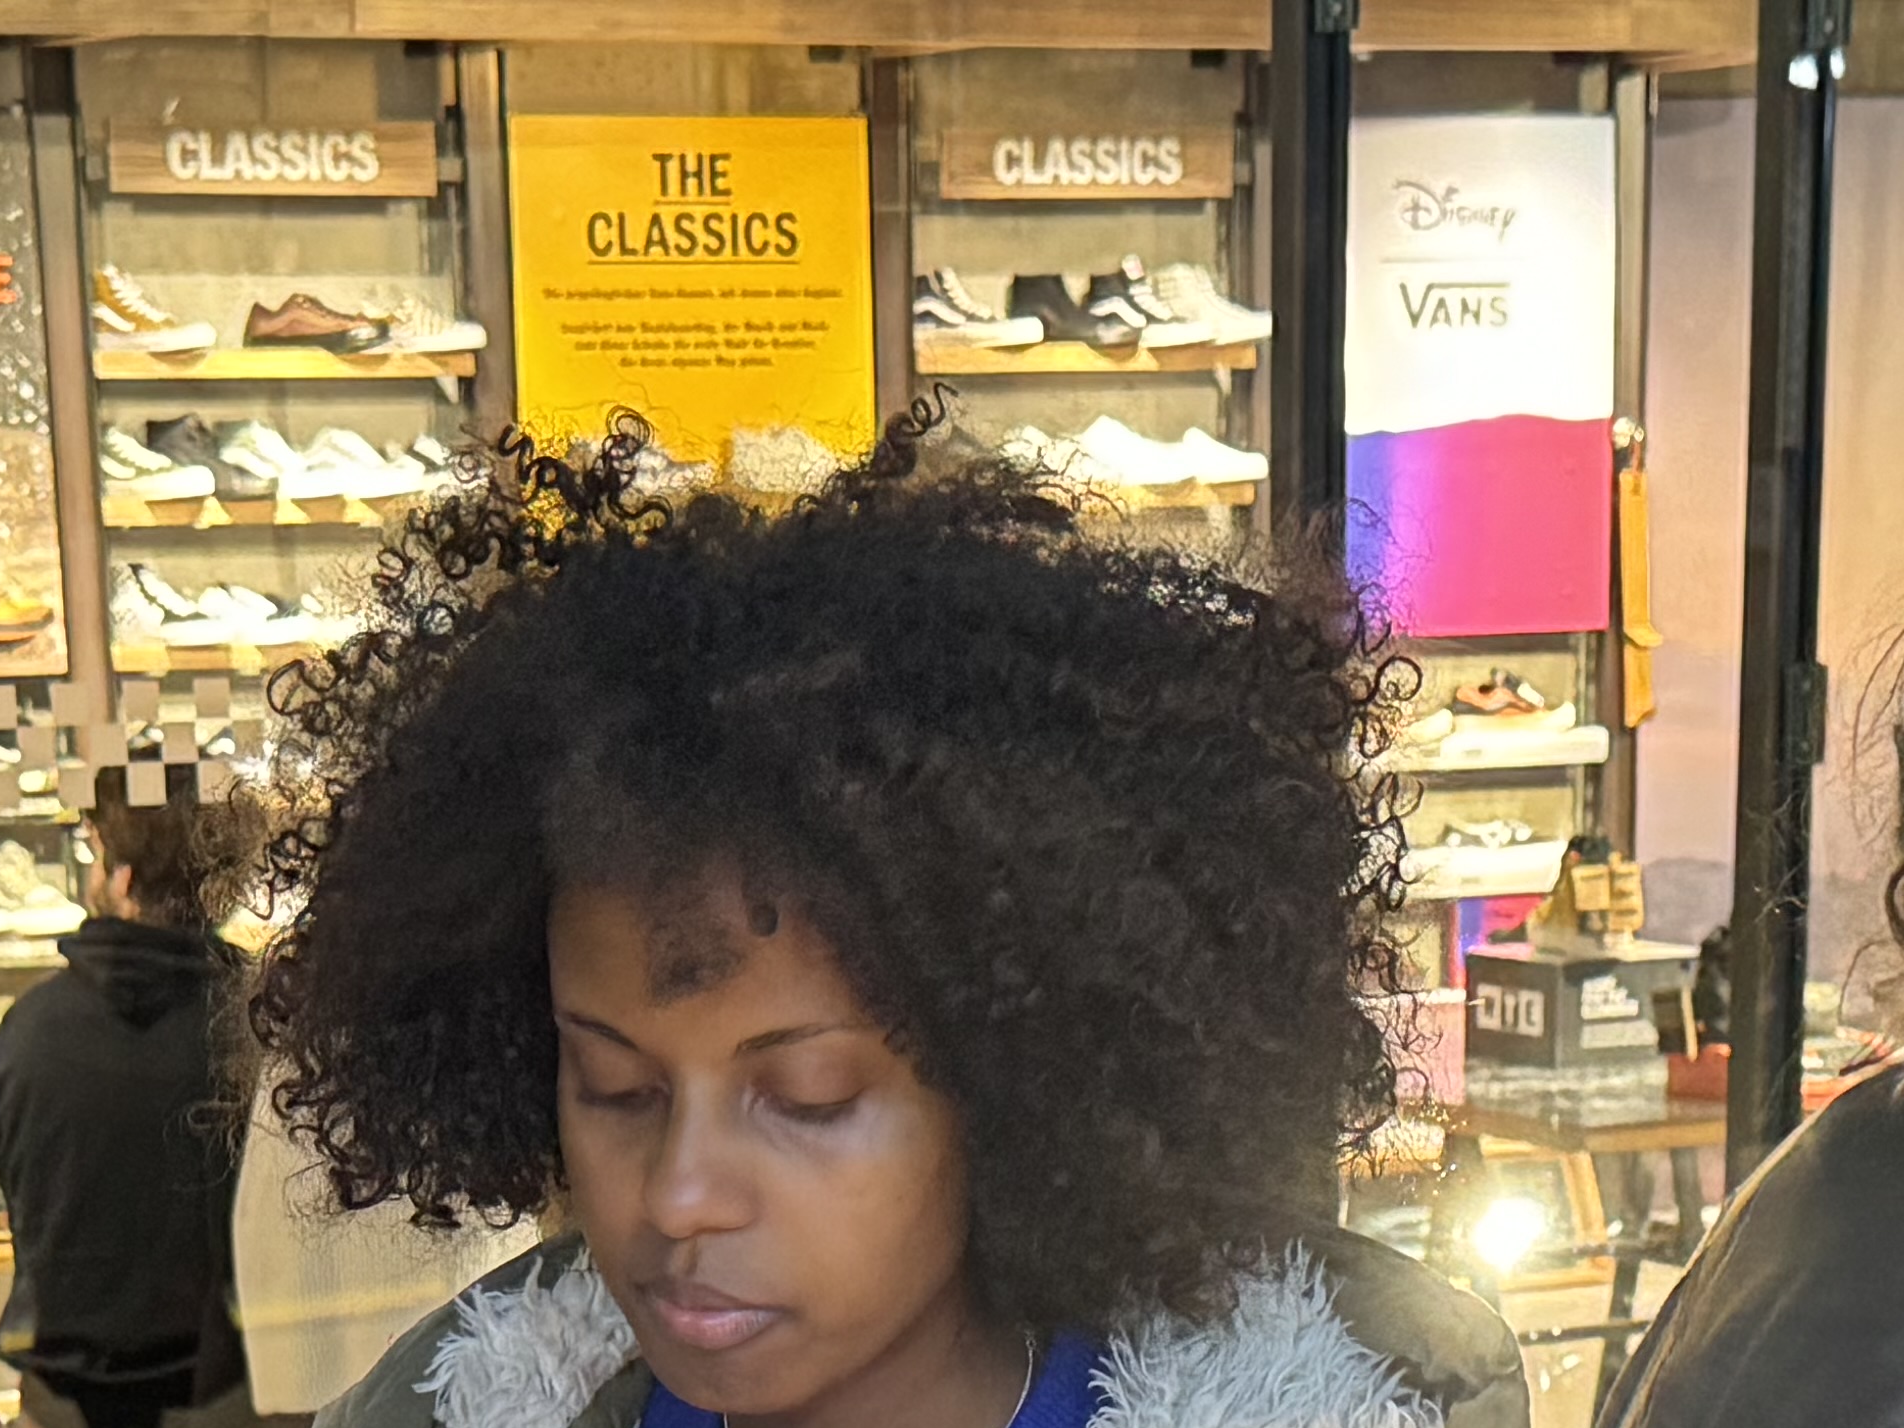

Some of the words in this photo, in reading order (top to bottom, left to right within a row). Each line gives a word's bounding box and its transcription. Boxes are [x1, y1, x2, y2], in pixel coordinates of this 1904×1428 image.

[166, 131, 379, 182] CLASSICS
[653, 152, 733, 197] THE
[993, 136, 1183, 186] CLASSICS
[1392, 180, 1516, 243] Disney
[586, 213, 800, 259] CLASSICS
[1399, 282, 1510, 328] VANS
